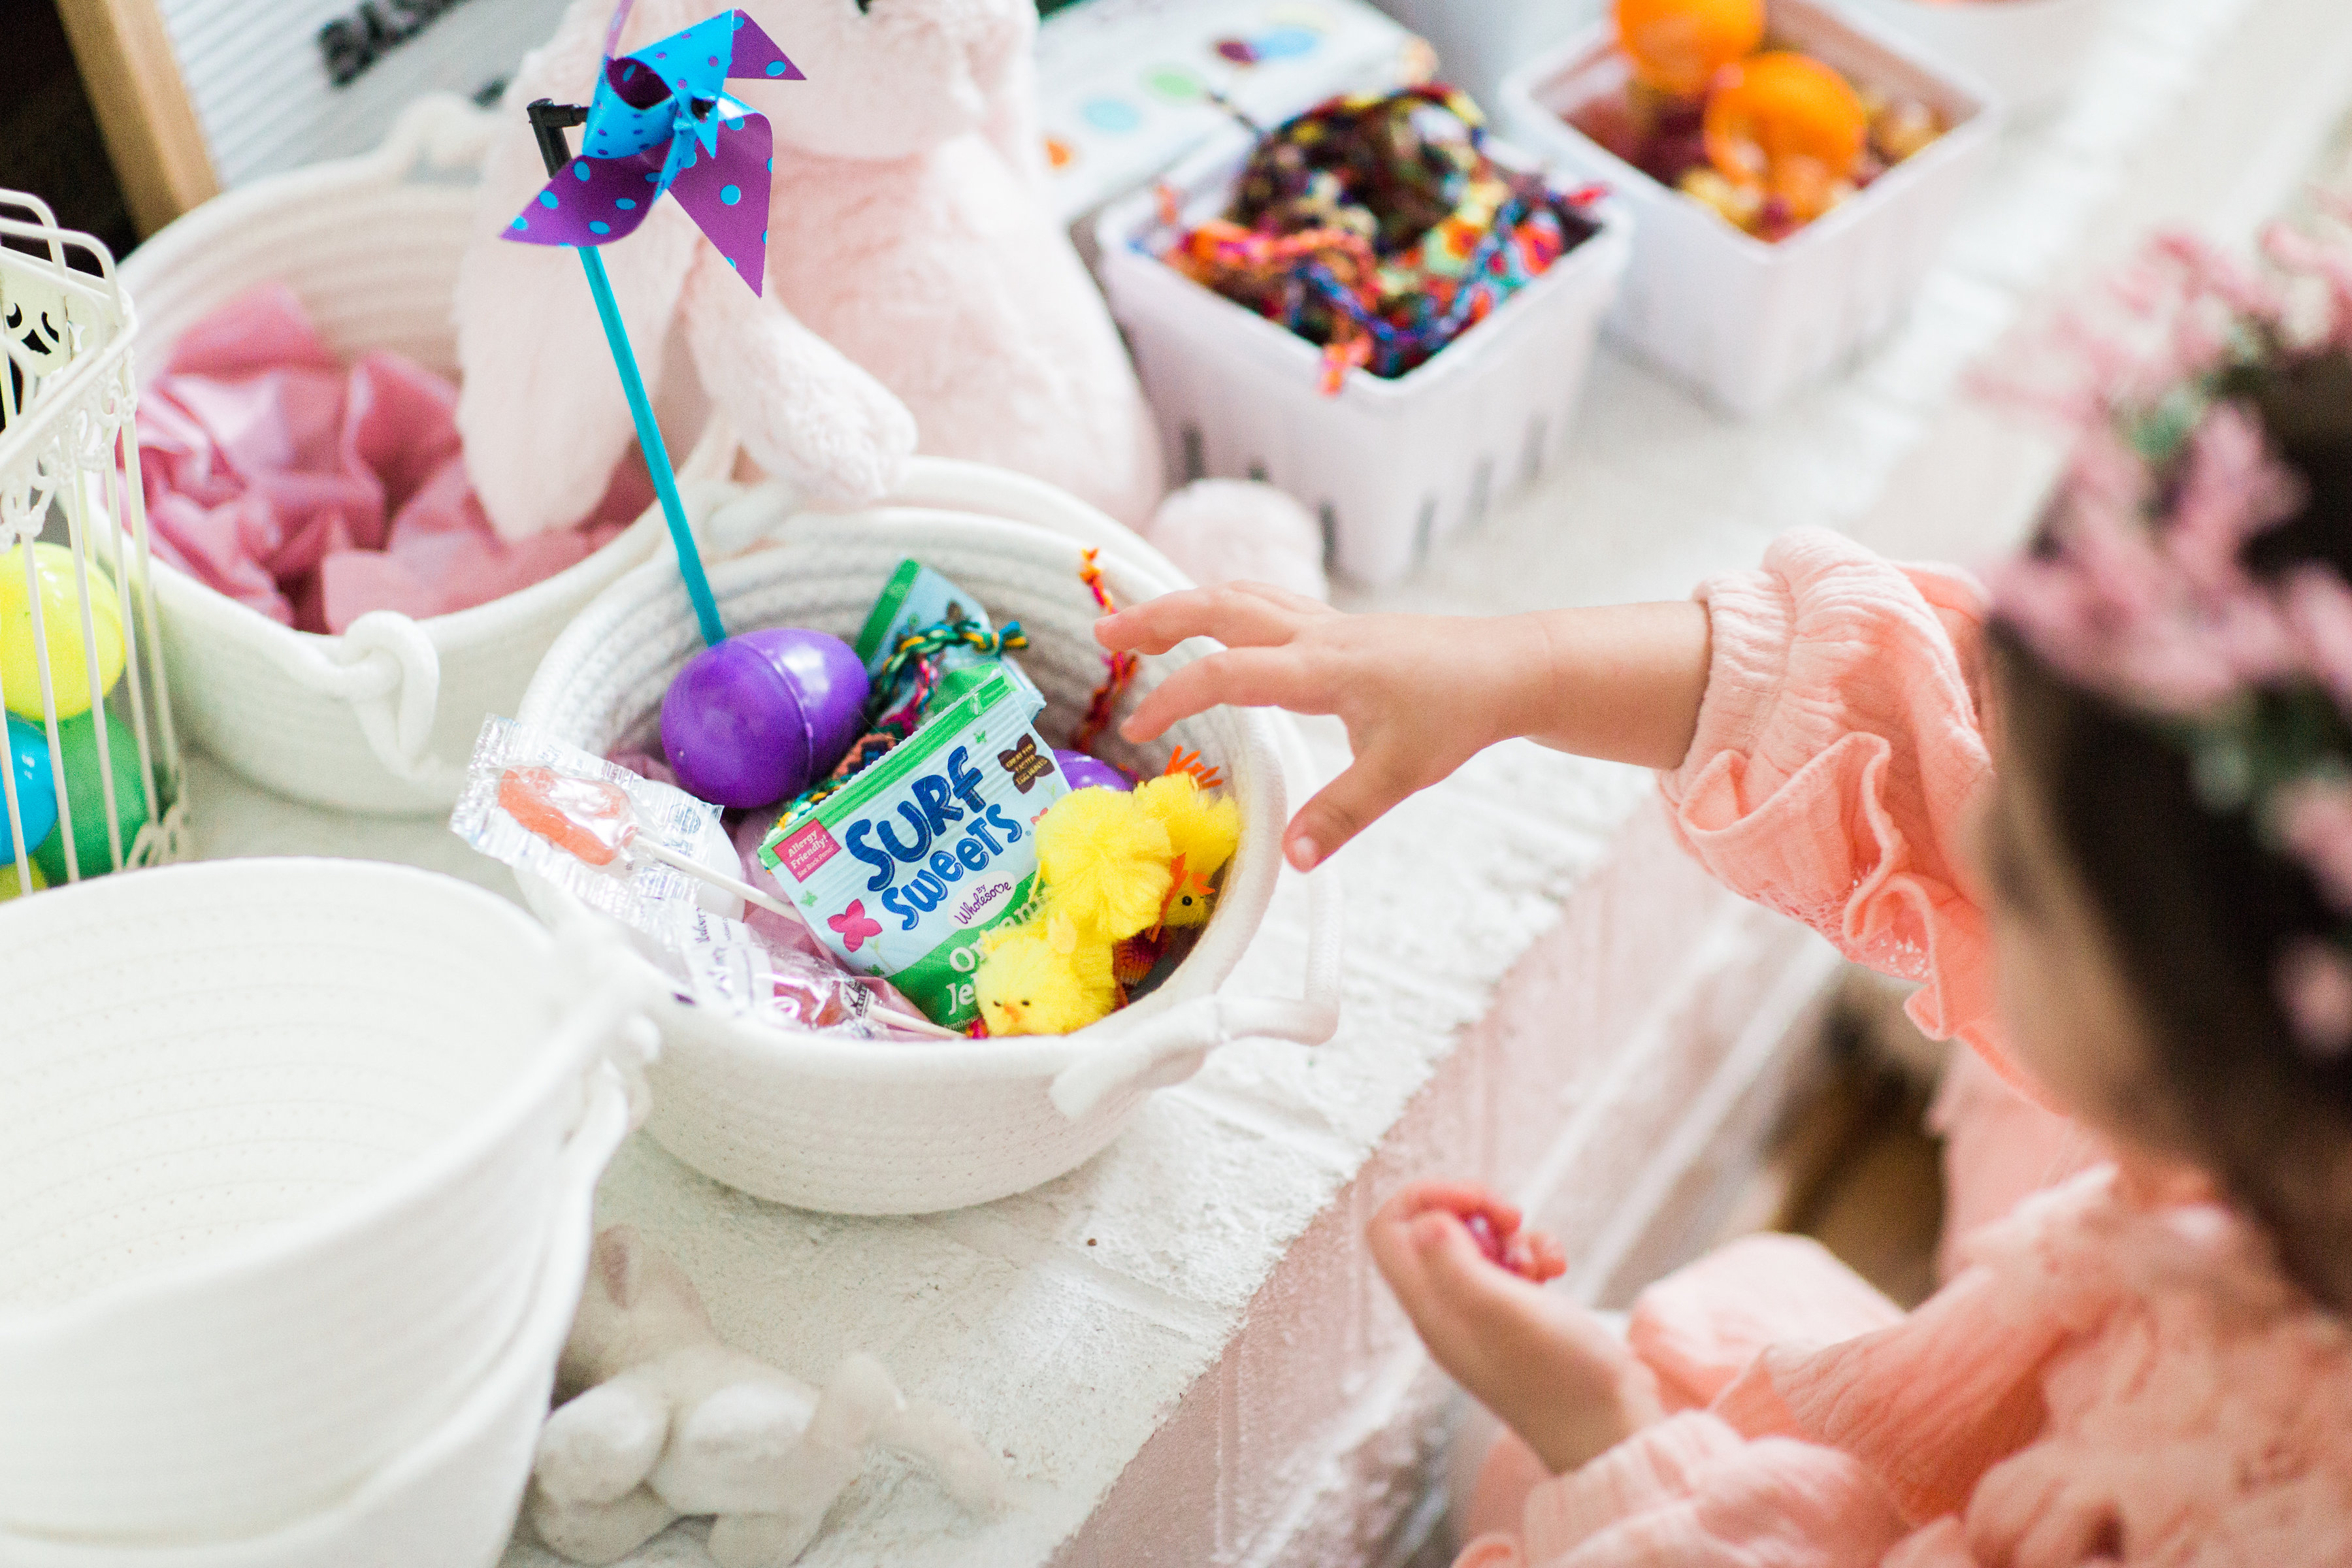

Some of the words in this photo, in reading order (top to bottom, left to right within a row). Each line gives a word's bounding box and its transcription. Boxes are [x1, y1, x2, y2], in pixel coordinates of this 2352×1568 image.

[788, 830, 817, 858] Allergy
[791, 834, 828, 870] Friendly!
[797, 868, 808, 878] See
[806, 857, 821, 870] Back
[975, 884, 987, 893] By
